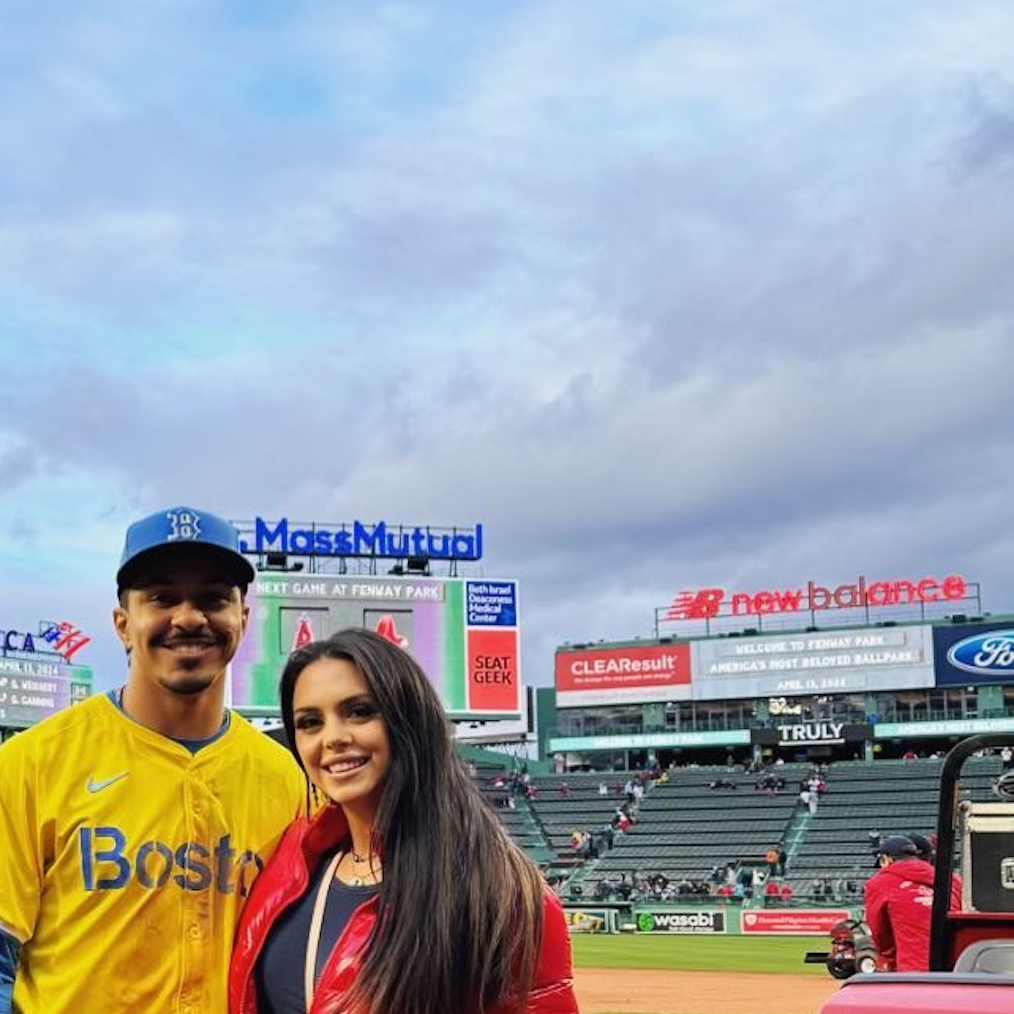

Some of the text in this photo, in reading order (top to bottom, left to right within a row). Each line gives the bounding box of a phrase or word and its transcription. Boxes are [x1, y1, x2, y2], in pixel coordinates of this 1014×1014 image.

[167, 512, 202, 540] B
[255, 517, 483, 559] MassMutual
[257, 582, 438, 598] NEXT GAME AT FENWAY PARK
[468, 583, 512, 595] Beth Israel
[731, 574, 967, 616] new balance
[468, 593, 513, 604] Deaconess
[468, 603, 502, 613] Medical
[469, 612, 498, 623] Center
[736, 636, 885, 654] WELCOME TO FENWAY PARK
[475, 655, 511, 670] SEAT
[571, 654, 676, 675] CLEAResult
[710, 651, 913, 673] AMERICA'S MOST BELOVED BALLPARK
[474, 670, 513, 685] GEEK
[777, 723, 844, 741] TRULY
[654, 911, 714, 927] wasabi
